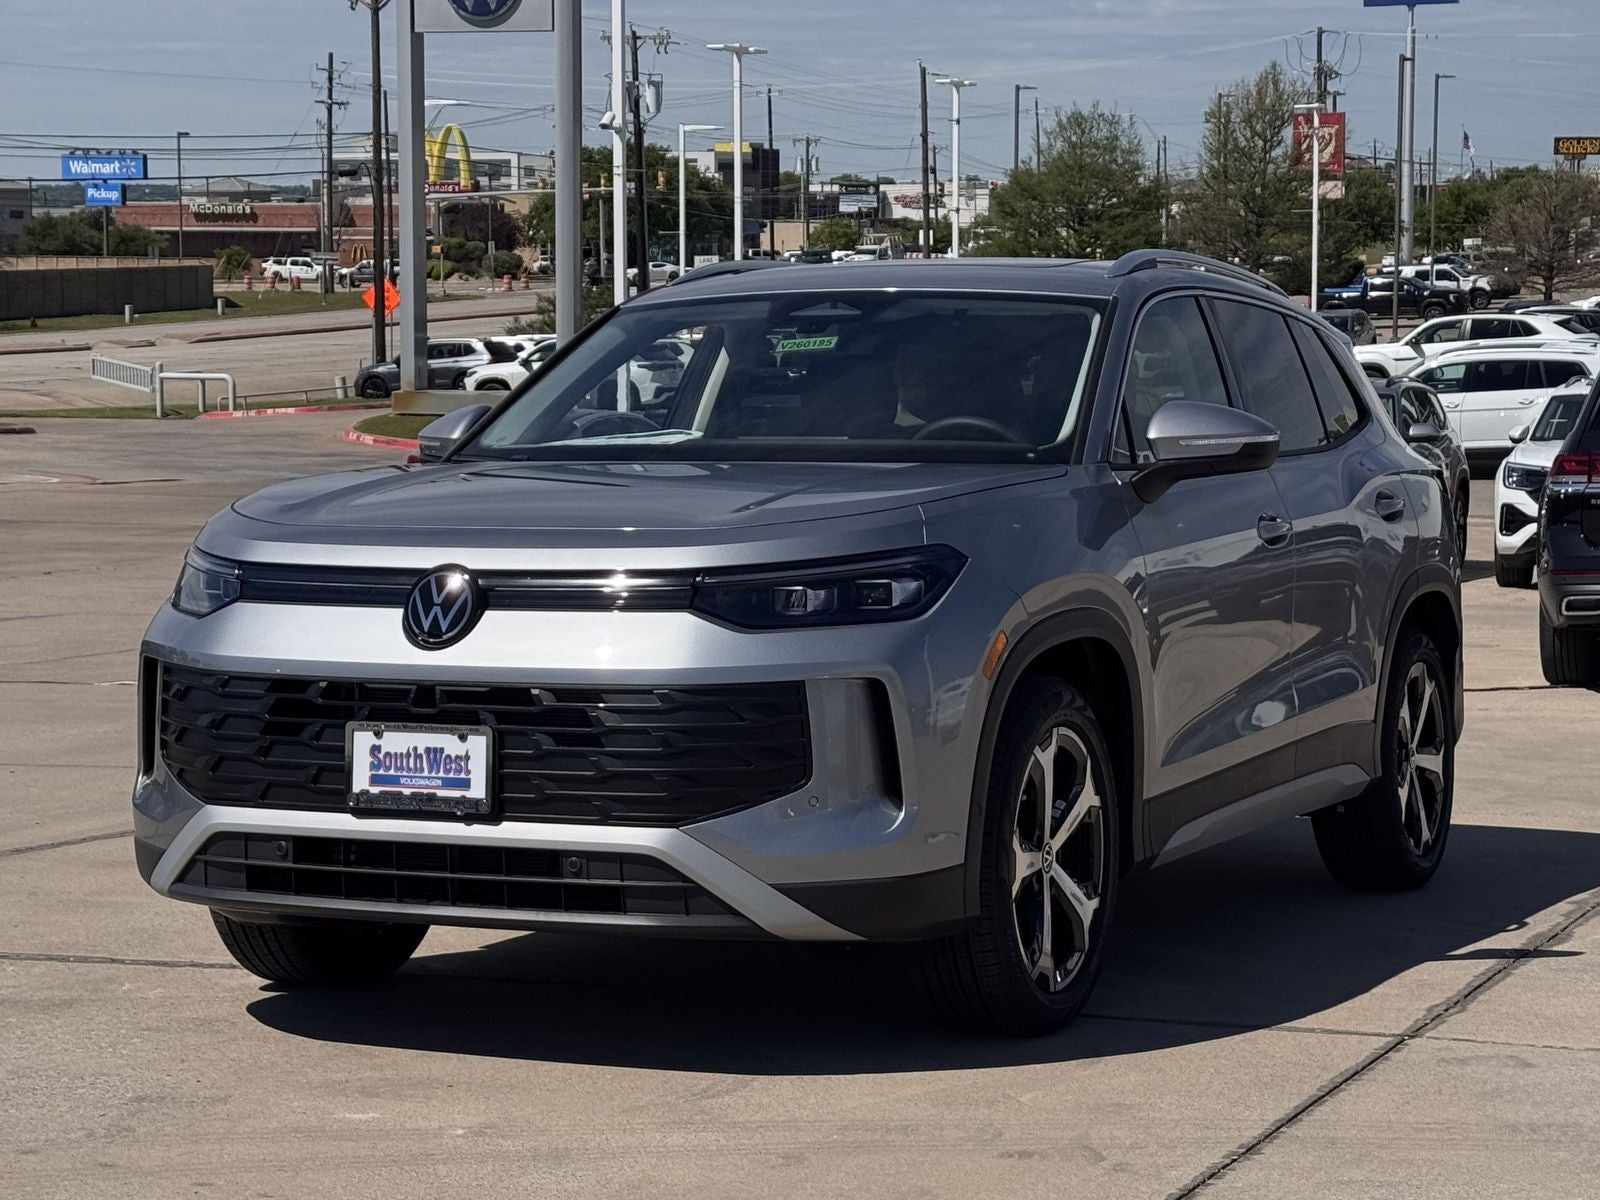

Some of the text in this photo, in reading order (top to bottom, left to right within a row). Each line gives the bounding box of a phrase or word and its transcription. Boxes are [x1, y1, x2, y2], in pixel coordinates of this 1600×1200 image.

[69, 160, 120, 174] Walmart
[87, 187, 119, 200] Pickup
[189, 203, 251, 214] McDonald's
[369, 743, 472, 776] SouthWest
[399, 776, 442, 787] VOLKSWAGEN
